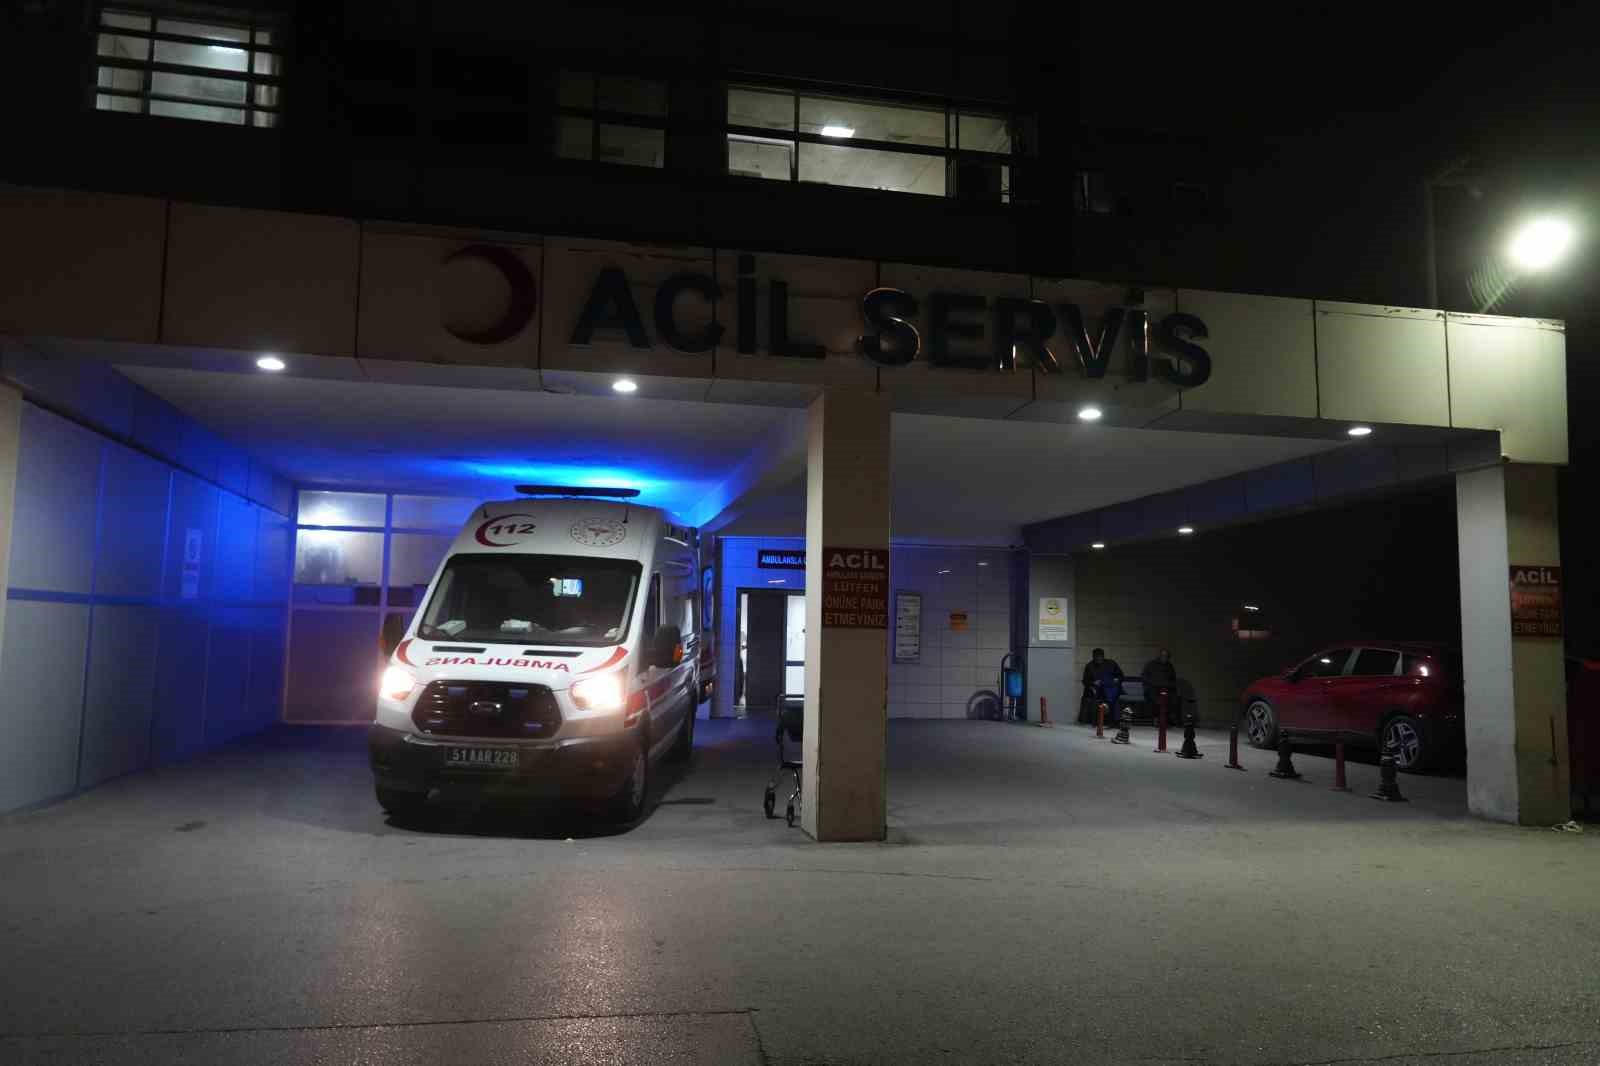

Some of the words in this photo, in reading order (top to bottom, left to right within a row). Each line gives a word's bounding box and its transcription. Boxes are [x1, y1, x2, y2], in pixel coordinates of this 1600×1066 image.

[569, 254, 826, 358] ACİL
[861, 286, 1212, 387] SERVİS
[490, 523, 537, 535] 112
[830, 550, 885, 568] ACİL
[1515, 568, 1560, 584] ACİL
